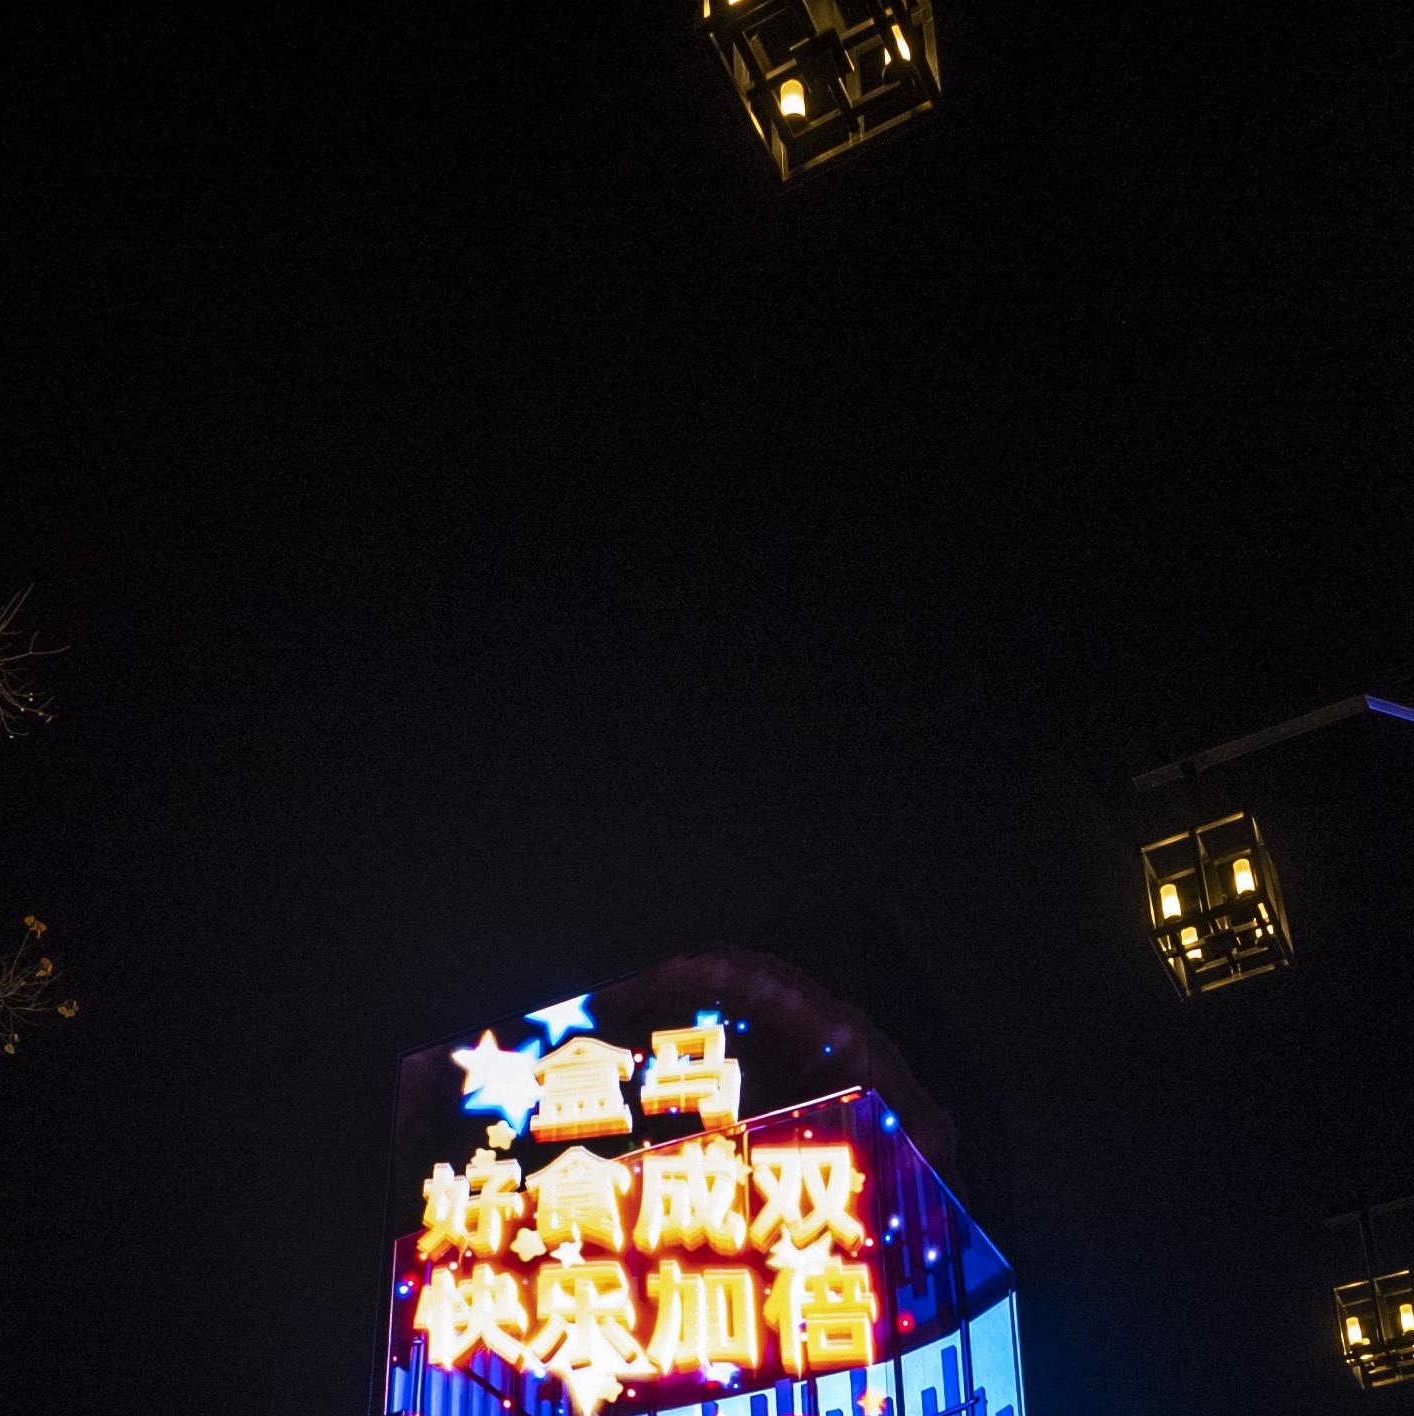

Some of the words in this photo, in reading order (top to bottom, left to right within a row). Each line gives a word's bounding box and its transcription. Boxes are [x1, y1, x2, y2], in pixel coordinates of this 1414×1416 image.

[529, 1024, 741, 1142] 盒马
[418, 1146, 864, 1259] 好食成双
[414, 1260, 875, 1375] 快乐加倍
